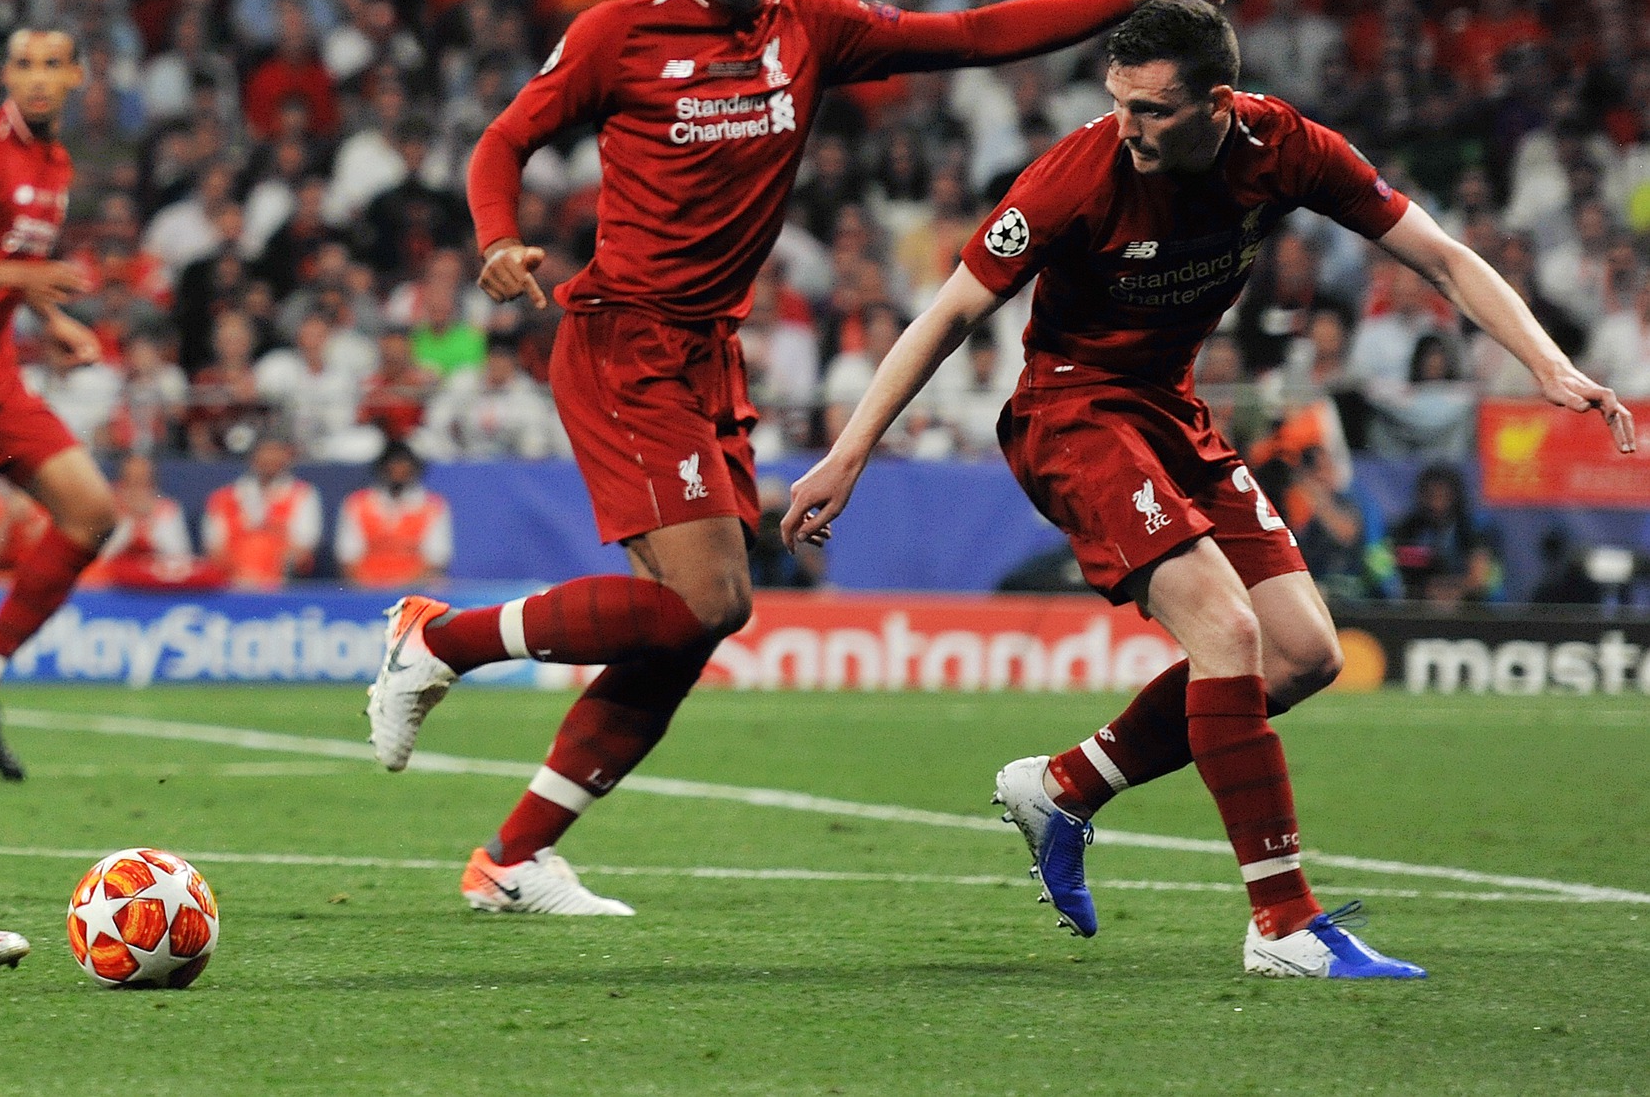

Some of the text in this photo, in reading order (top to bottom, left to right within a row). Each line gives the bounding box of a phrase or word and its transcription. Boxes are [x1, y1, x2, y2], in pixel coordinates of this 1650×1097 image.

[676, 92, 766, 120] Standard
[670, 113, 769, 144] Chartered
[1119, 251, 1233, 290] Standard
[1109, 272, 1231, 306] Chartered
[1145, 513, 1173, 536] LFC
